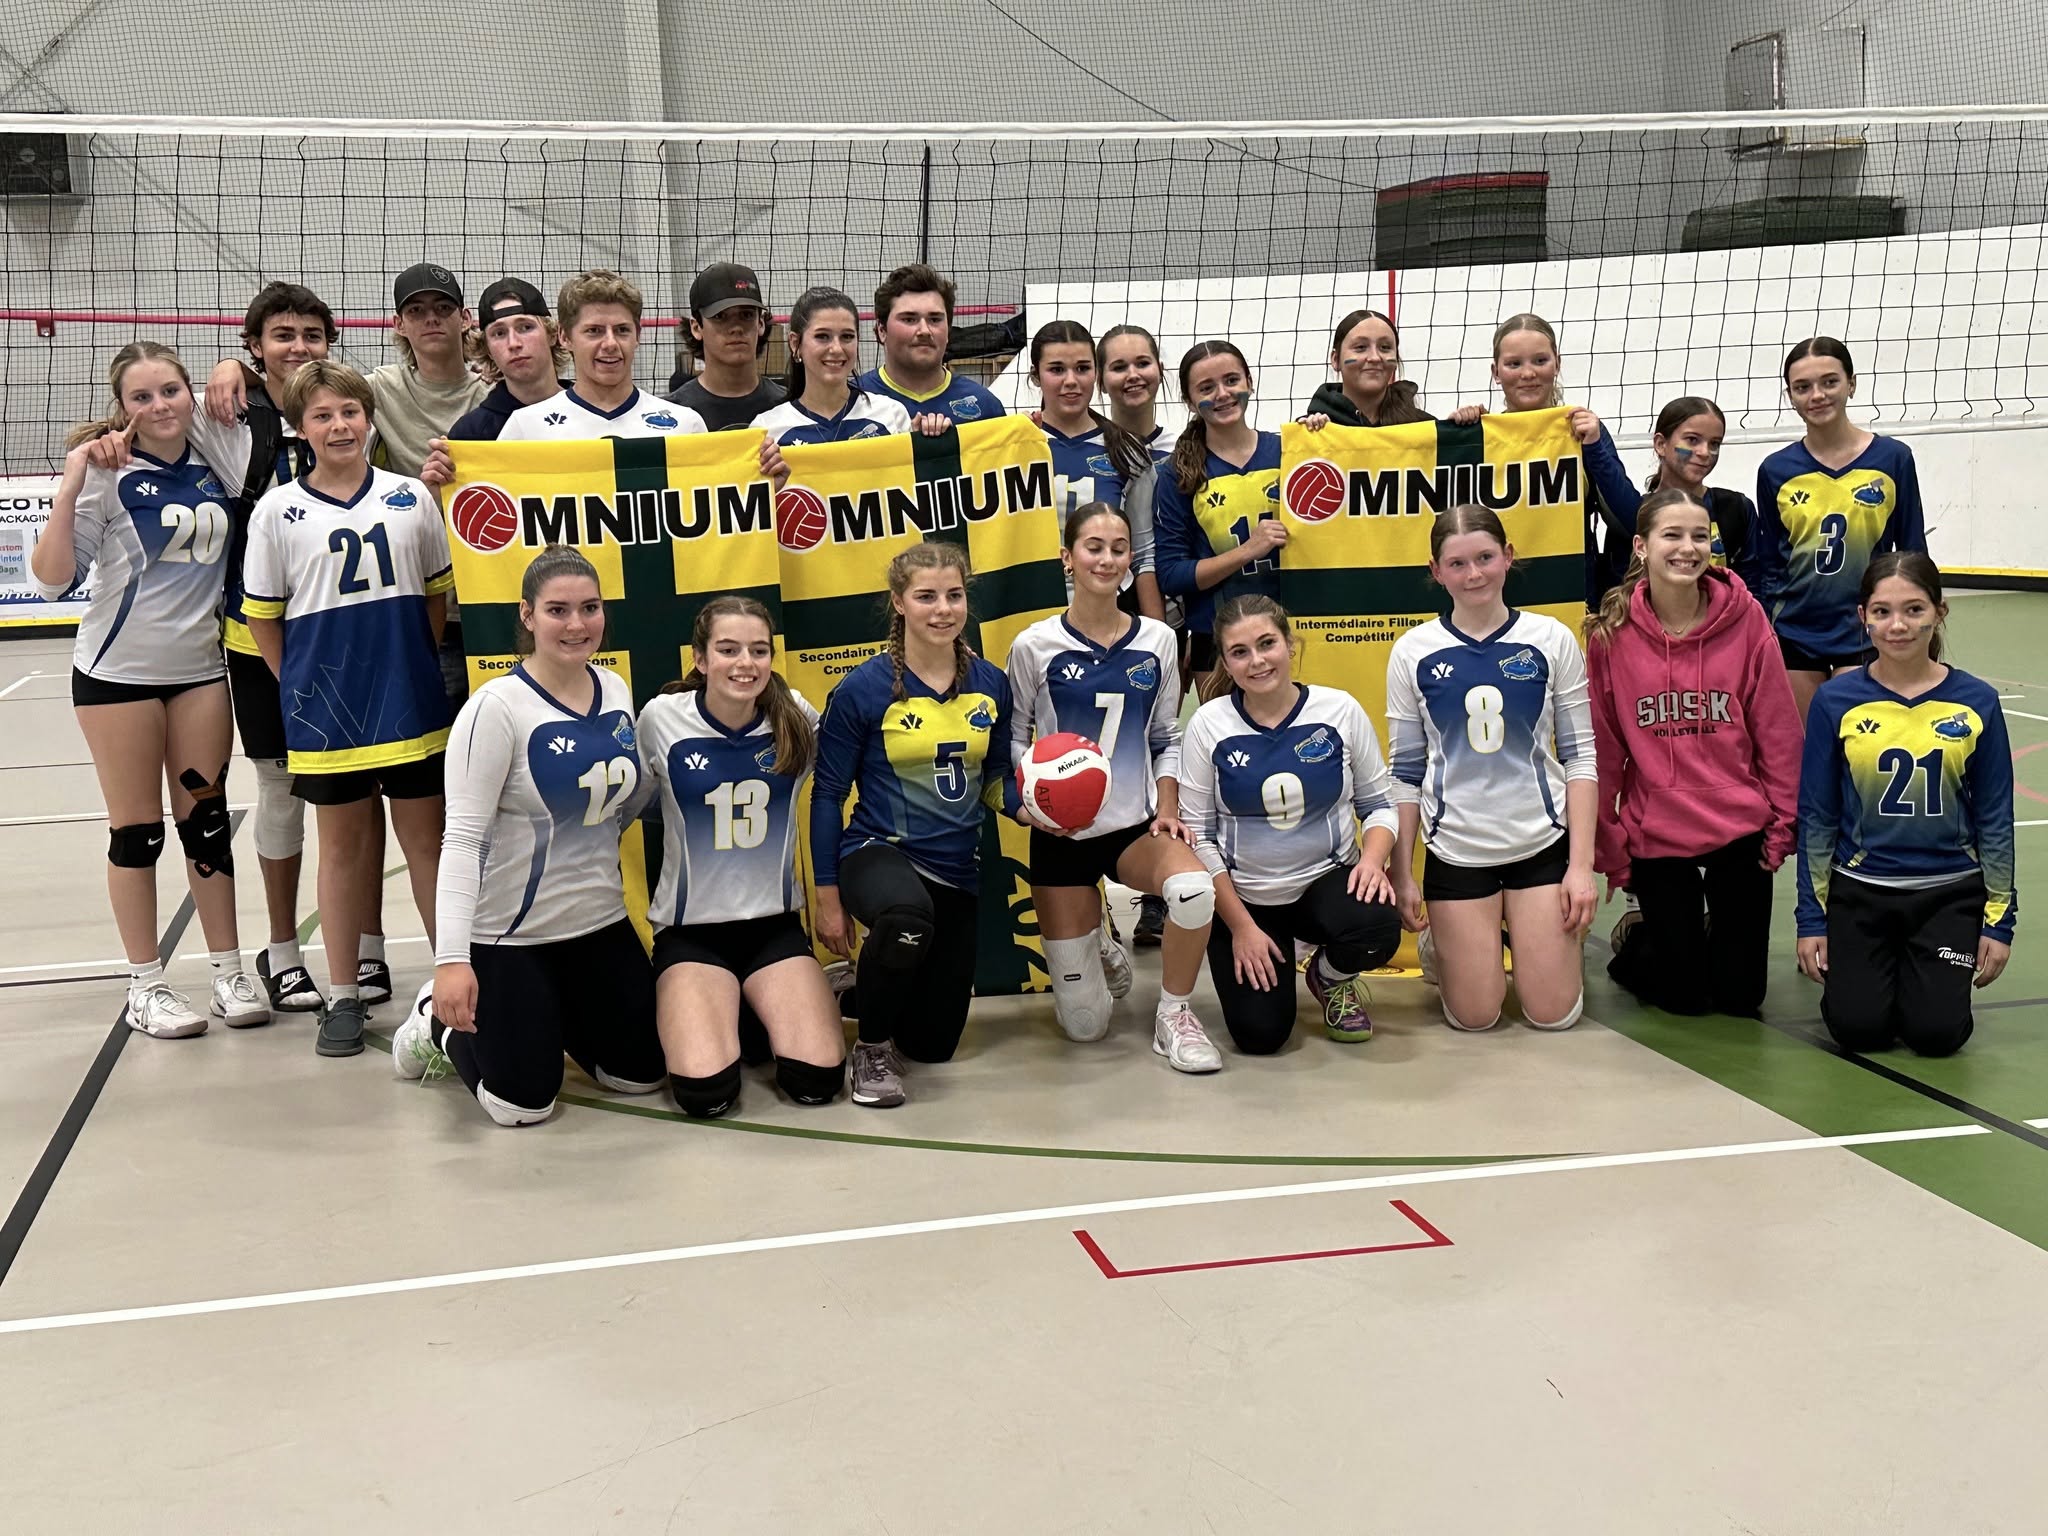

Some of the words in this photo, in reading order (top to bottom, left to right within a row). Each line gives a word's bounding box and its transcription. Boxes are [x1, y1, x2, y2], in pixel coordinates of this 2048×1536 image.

[158, 502, 229, 565] 20
[328, 522, 397, 595] 21
[1814, 513, 1849, 576] 3
[799, 647, 876, 663] Secondaire
[1296, 618, 1385, 630] Intermédiaire
[1325, 632, 1395, 644] Compétitif
[1095, 692, 1125, 759] 7
[1464, 685, 1505, 754] 8
[1637, 690, 1734, 728] SASK
[578, 756, 637, 827] 12
[934, 741, 968, 802] 5
[1261, 772, 1305, 831] 9
[1877, 748, 1944, 817] 21
[704, 779, 771, 850] 13
[281, 970, 303, 987] NIKE
[359, 963, 381, 973] NIKE
